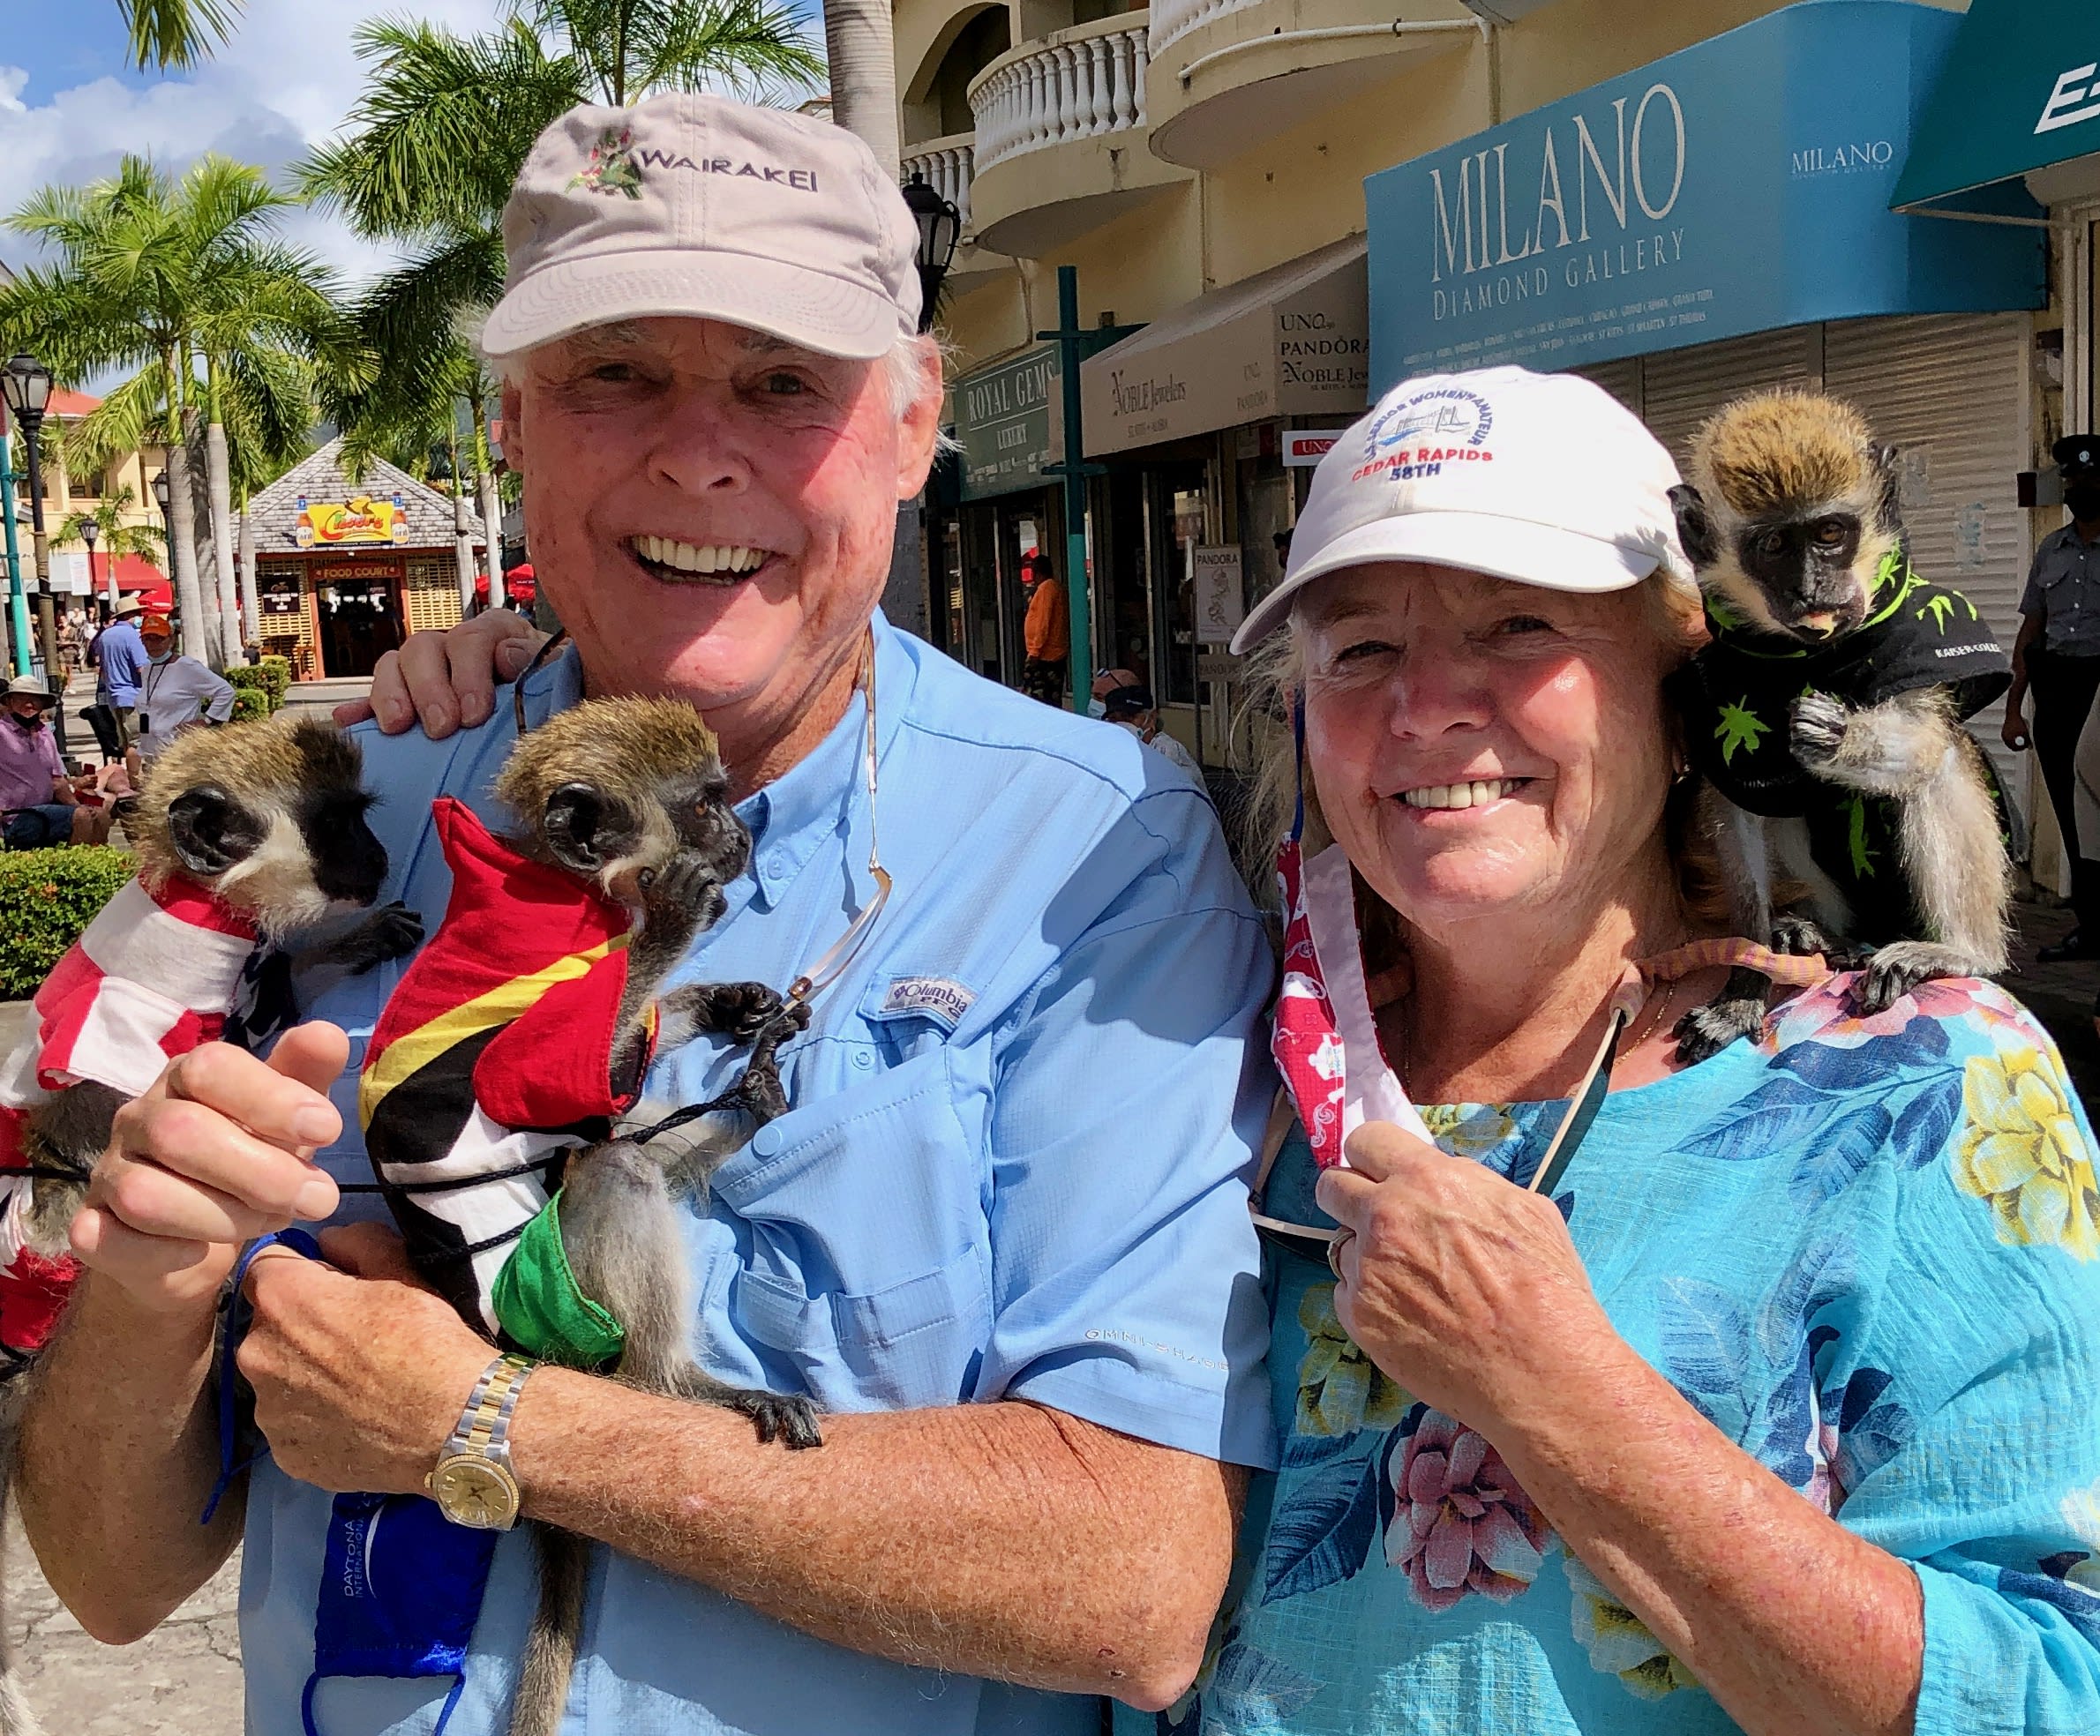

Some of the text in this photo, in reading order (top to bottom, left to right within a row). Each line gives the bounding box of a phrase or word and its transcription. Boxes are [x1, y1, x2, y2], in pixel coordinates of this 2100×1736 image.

[2033, 62, 2100, 134] E
[641, 149, 818, 192] WAIRAKEI
[1792, 141, 1893, 172] MILANO
[1429, 84, 1685, 282] MILANO
[1434, 228, 1684, 320] DIAMOND GALLERY
[967, 378, 1011, 423] ROYAL
[1352, 447, 1494, 483] CEDAR RAPIDS
[1388, 461, 1442, 482] 58TH
[324, 565, 388, 579] FOOD COURT
[1196, 554, 1239, 565] PANDORA
[905, 983, 968, 1013] Columbia
[343, 1519, 356, 1598] DAYTONA
